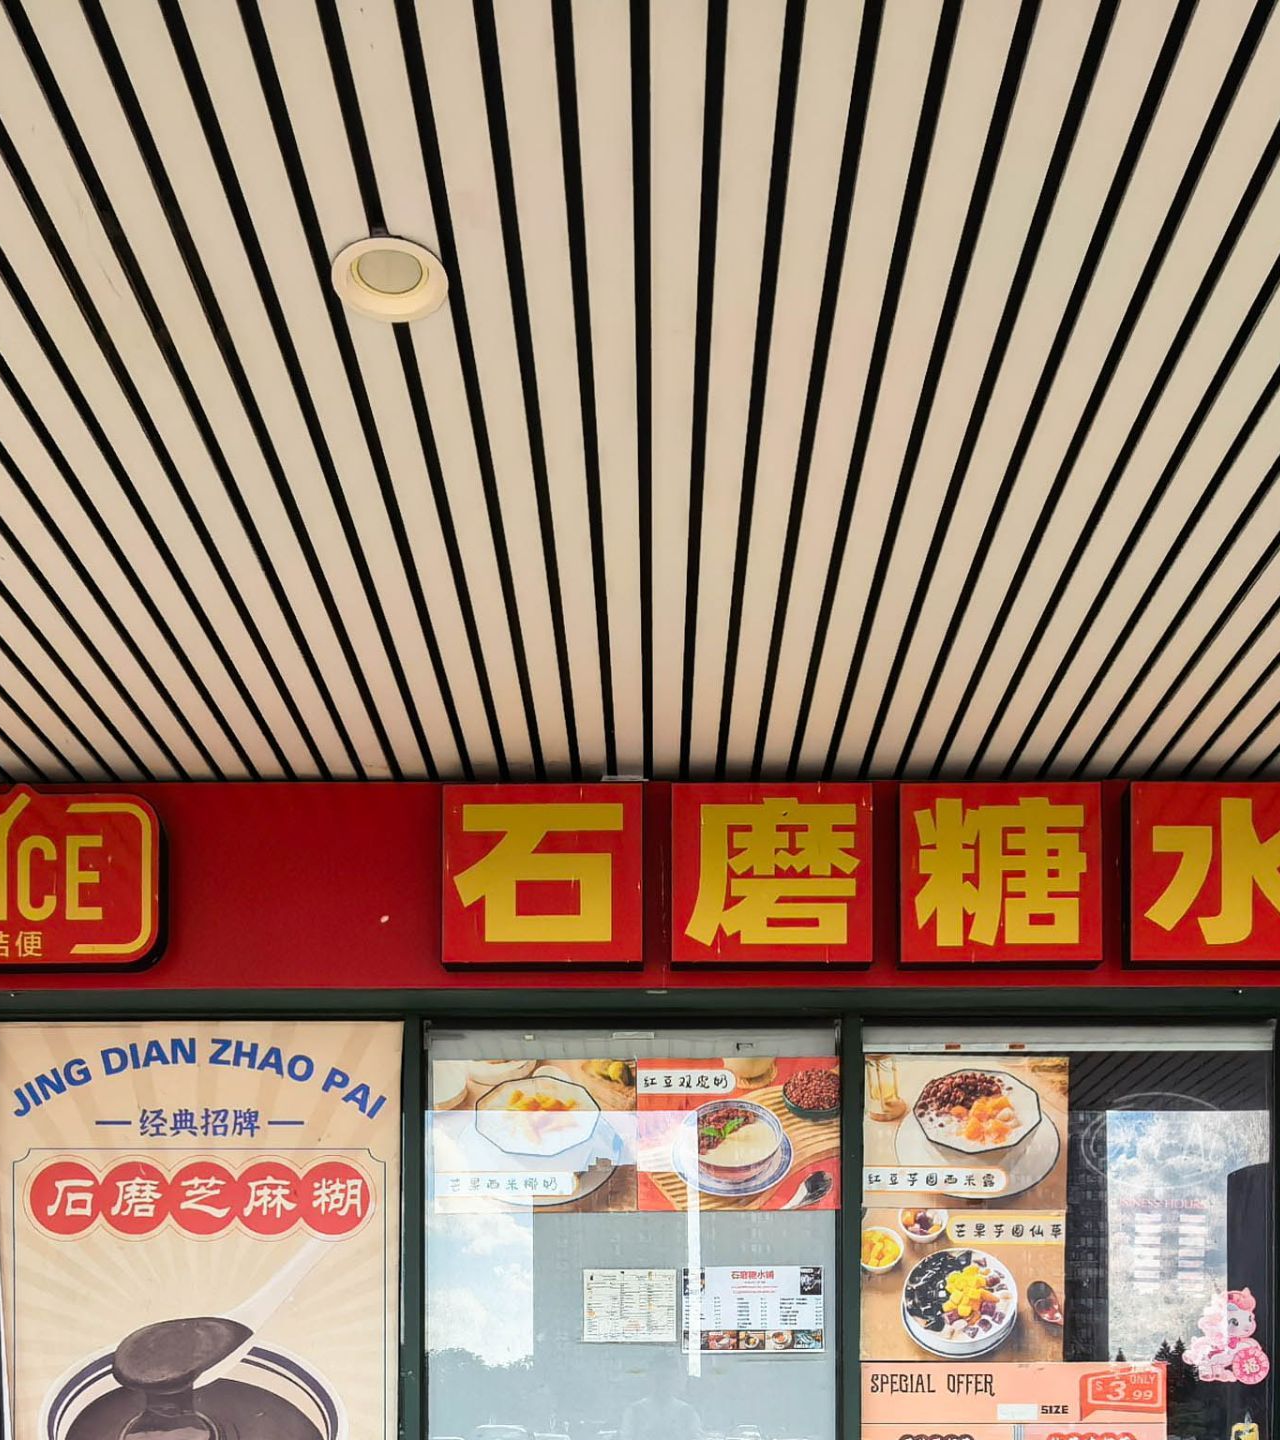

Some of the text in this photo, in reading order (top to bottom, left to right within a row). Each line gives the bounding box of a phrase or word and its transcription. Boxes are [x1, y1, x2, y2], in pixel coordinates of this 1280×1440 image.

[12, 1037, 388, 1120] JING DIAN ZHAO PAI
[139, 1108, 261, 1138] 经典招牌
[46, 1176, 364, 1219] 石磨芝麻糊
[870, 1373, 995, 1397] SPECIAL OFFER
[1041, 1405, 1069, 1414] SIZE
